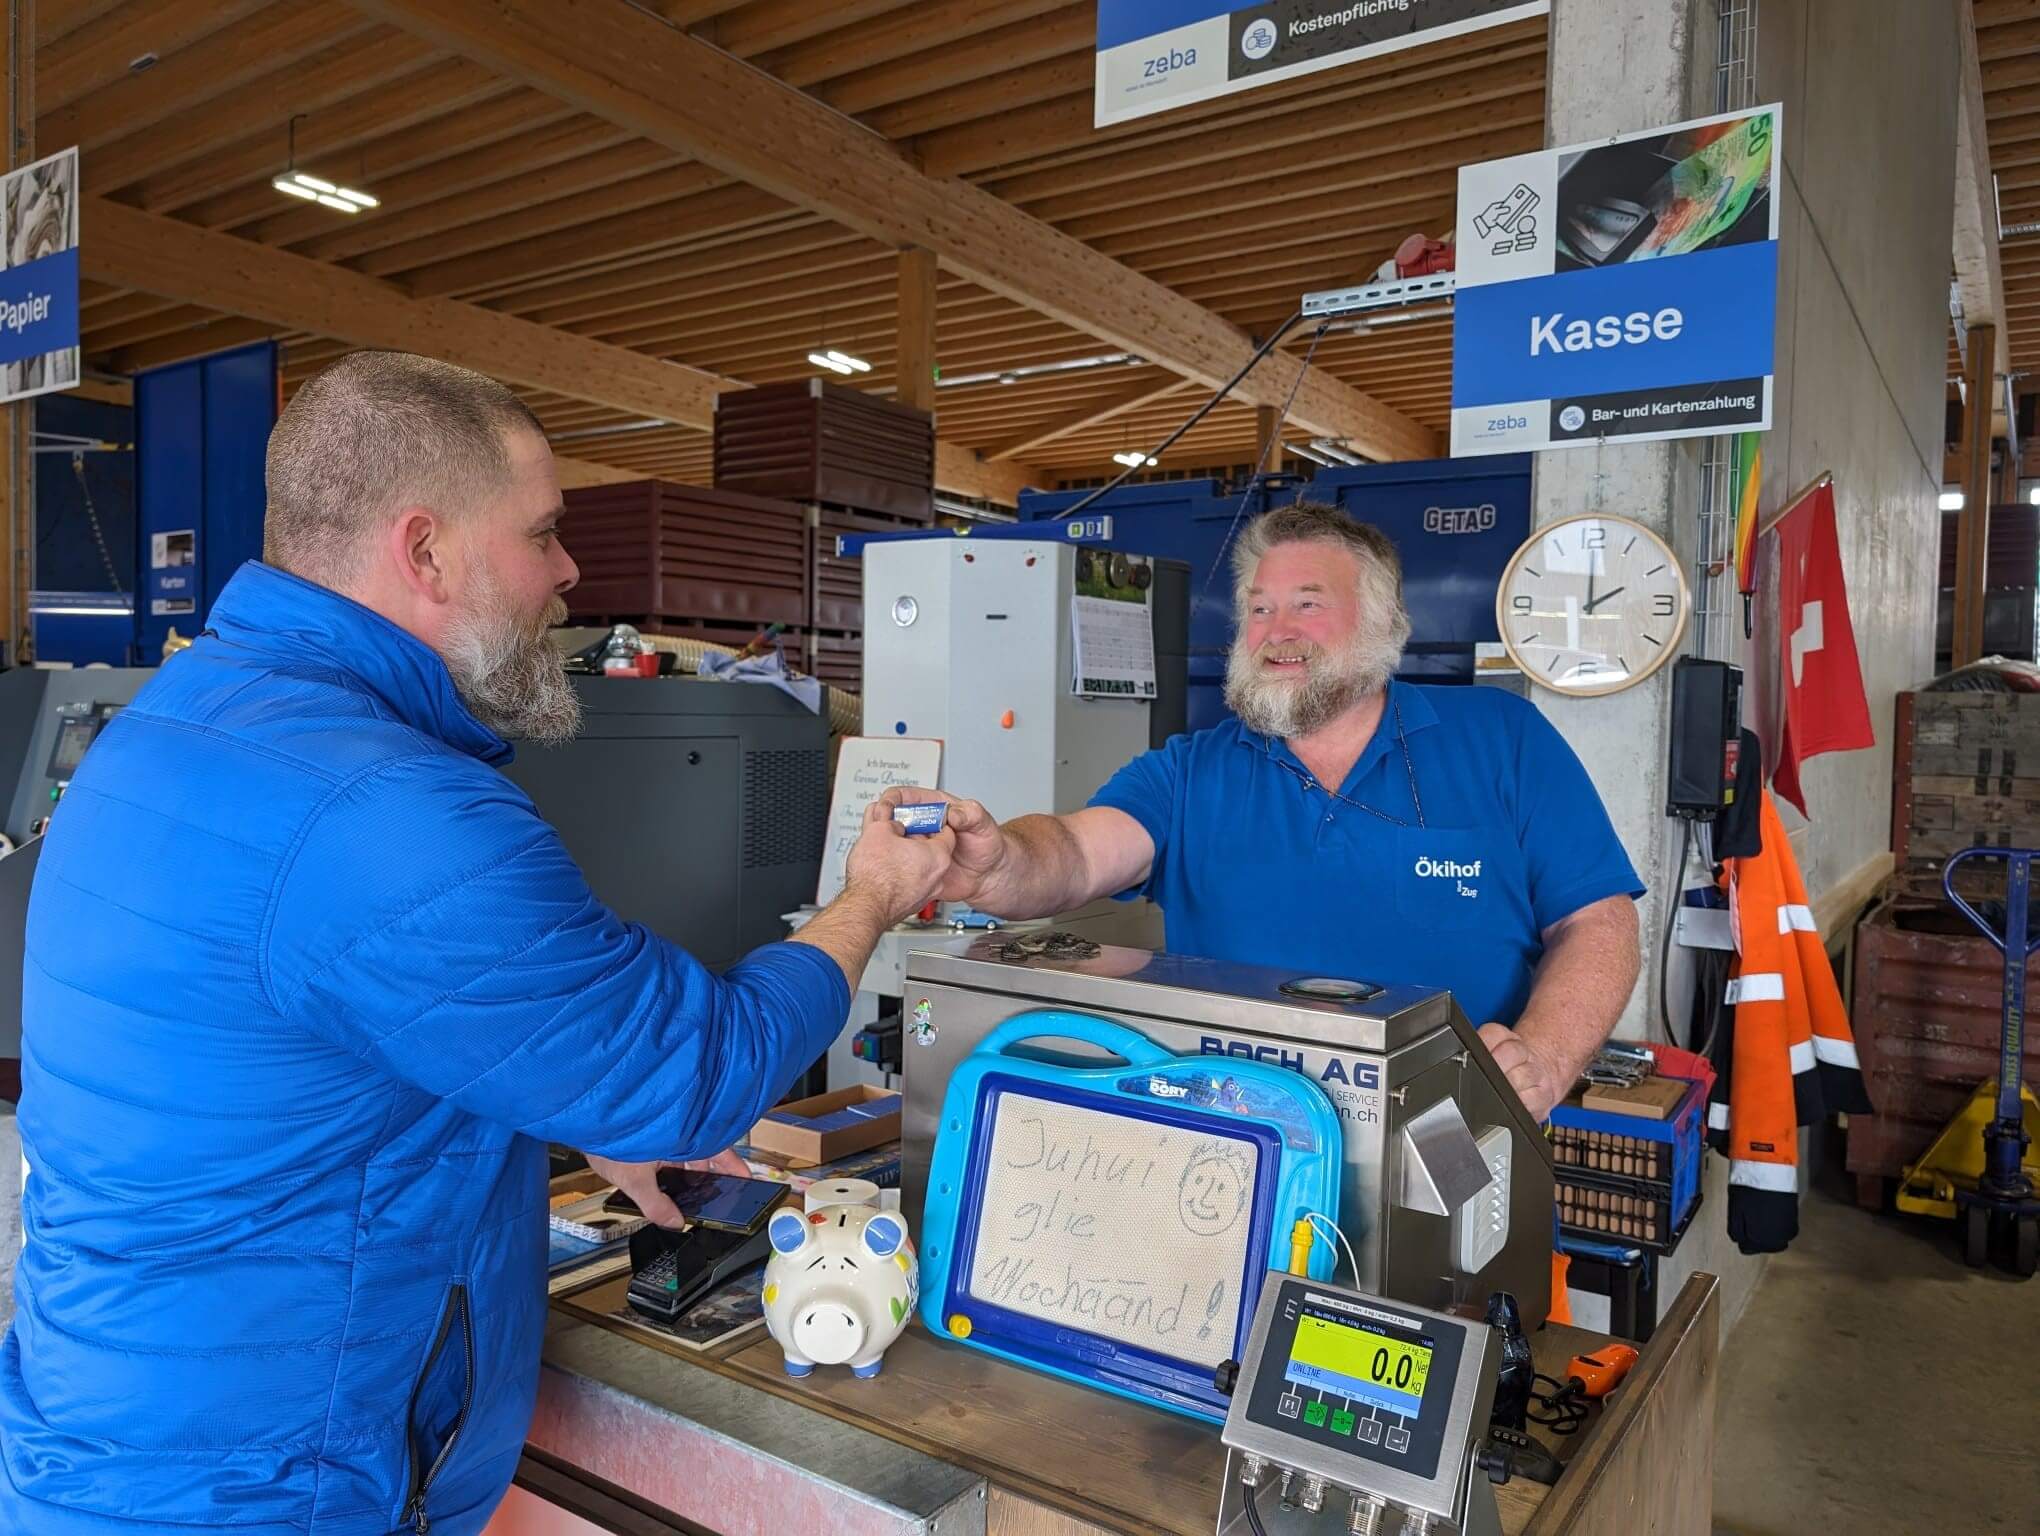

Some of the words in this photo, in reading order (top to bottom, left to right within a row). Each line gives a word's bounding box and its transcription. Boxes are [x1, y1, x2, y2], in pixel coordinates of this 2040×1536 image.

[1289, 0, 1409, 37] Kostenpflichtig
[1144, 48, 1197, 77] zeba
[0, 292, 51, 334] Papier
[1530, 307, 1683, 357] Kasse
[1592, 408, 1621, 422] Bar-
[1623, 405, 1649, 419] und
[1651, 395, 1756, 416] Kartenzahlung
[1487, 415, 1527, 431] zeba
[1424, 504, 1496, 534] GETAG
[1580, 527, 1606, 549] 12
[1513, 595, 1532, 616] 9
[1652, 594, 1674, 616] 3
[1415, 856, 1481, 877] Ökihof
[1461, 887, 1478, 898] Zug
[1321, 1058, 1379, 1089] AG
[1150, 1082, 1189, 1098] DORY
[1337, 1090, 1378, 1107] SERVICE
[1007, 1118, 1168, 1188] Juhui
[1292, 1362, 1321, 1378] ONLINE
[1371, 1347, 1413, 1389] 0.0
[1411, 1377, 1422, 1394] kg
